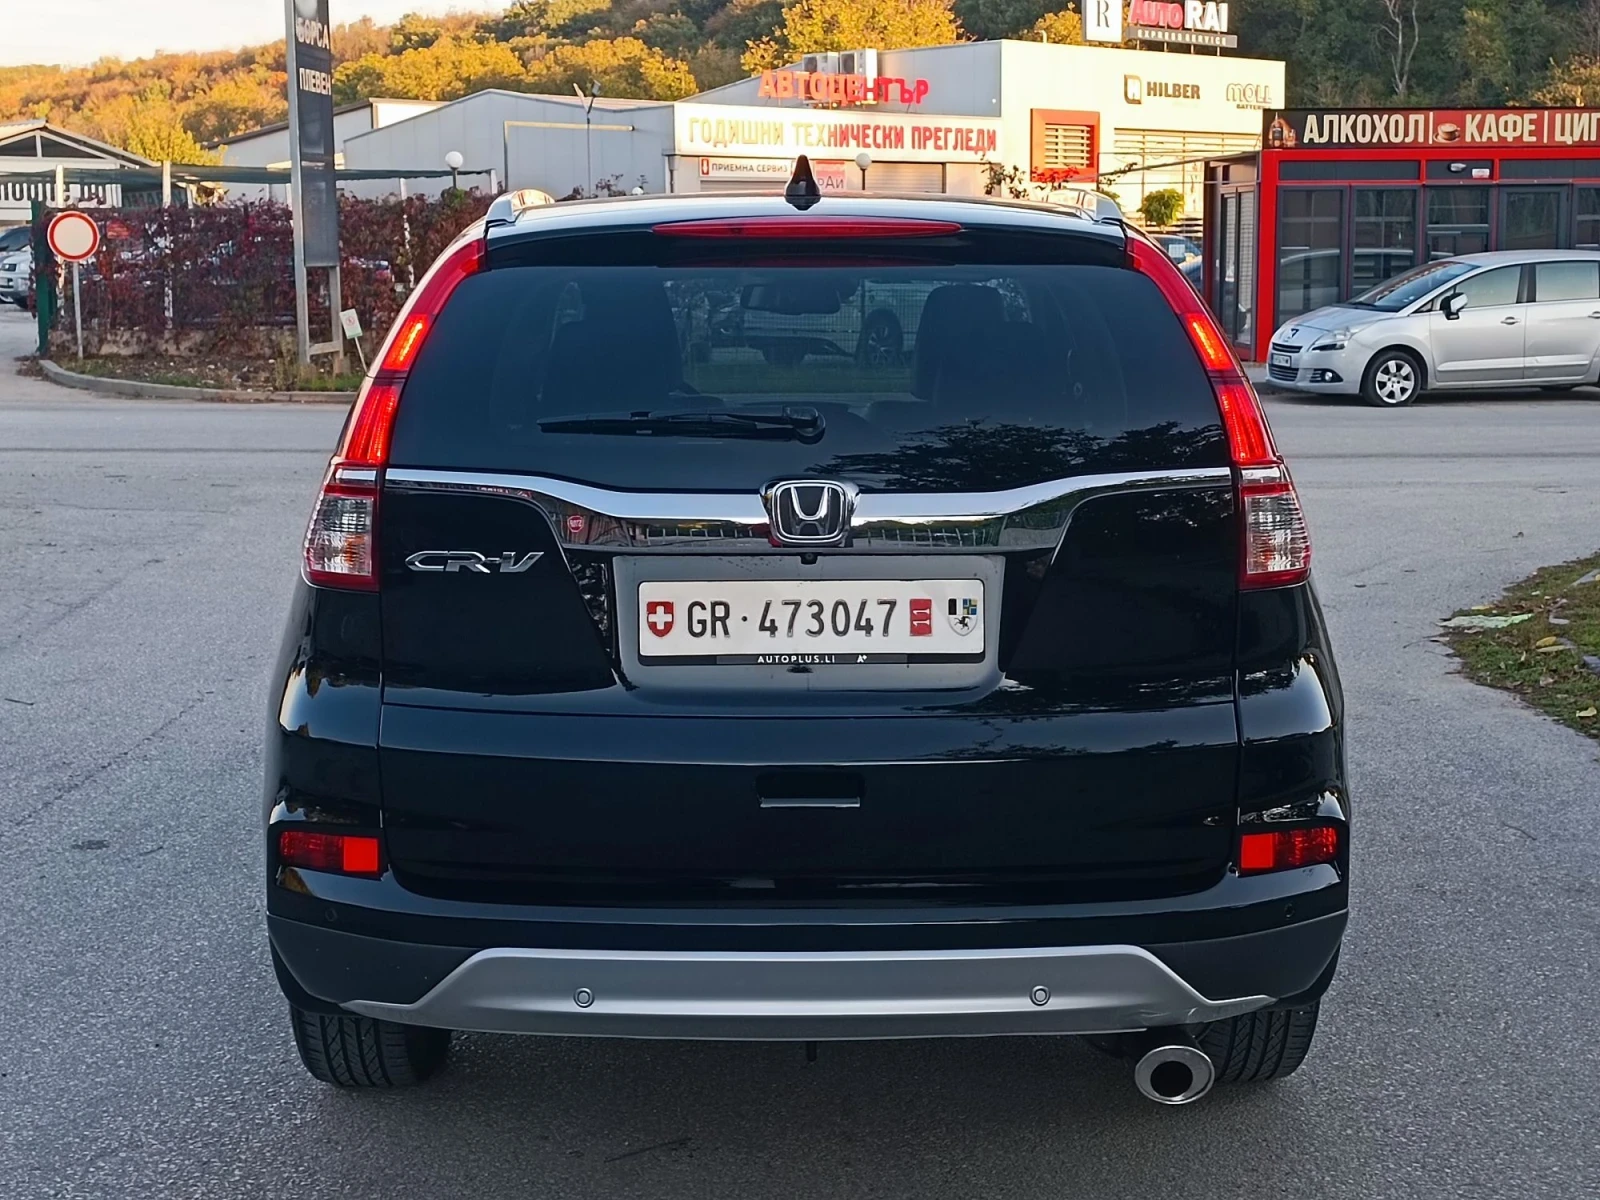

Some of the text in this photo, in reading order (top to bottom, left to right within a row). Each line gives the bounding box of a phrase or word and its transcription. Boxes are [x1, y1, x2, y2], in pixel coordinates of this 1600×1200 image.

[1184, 0, 1229, 32] RAI
[1137, 29, 1227, 46] EXPRESS SERVICE
[299, 67, 332, 96] ПЛЕВЕН
[757, 69, 930, 106] АВТОЦЕНТЪР
[1146, 81, 1200, 99] HILBER
[688, 117, 997, 154] ГОДИШНИ ТЕХНИЧЕСКИ ПРЕГЛЕДИ
[1303, 114, 1425, 143] АЛКОХОЛ
[1465, 113, 1538, 143] КАФЕ
[711, 163, 788, 173] ПРИЕМНА СЕРВИЗ
[405, 550, 545, 573] CR-V
[757, 655, 835, 663] AUTOPLUS.LI
